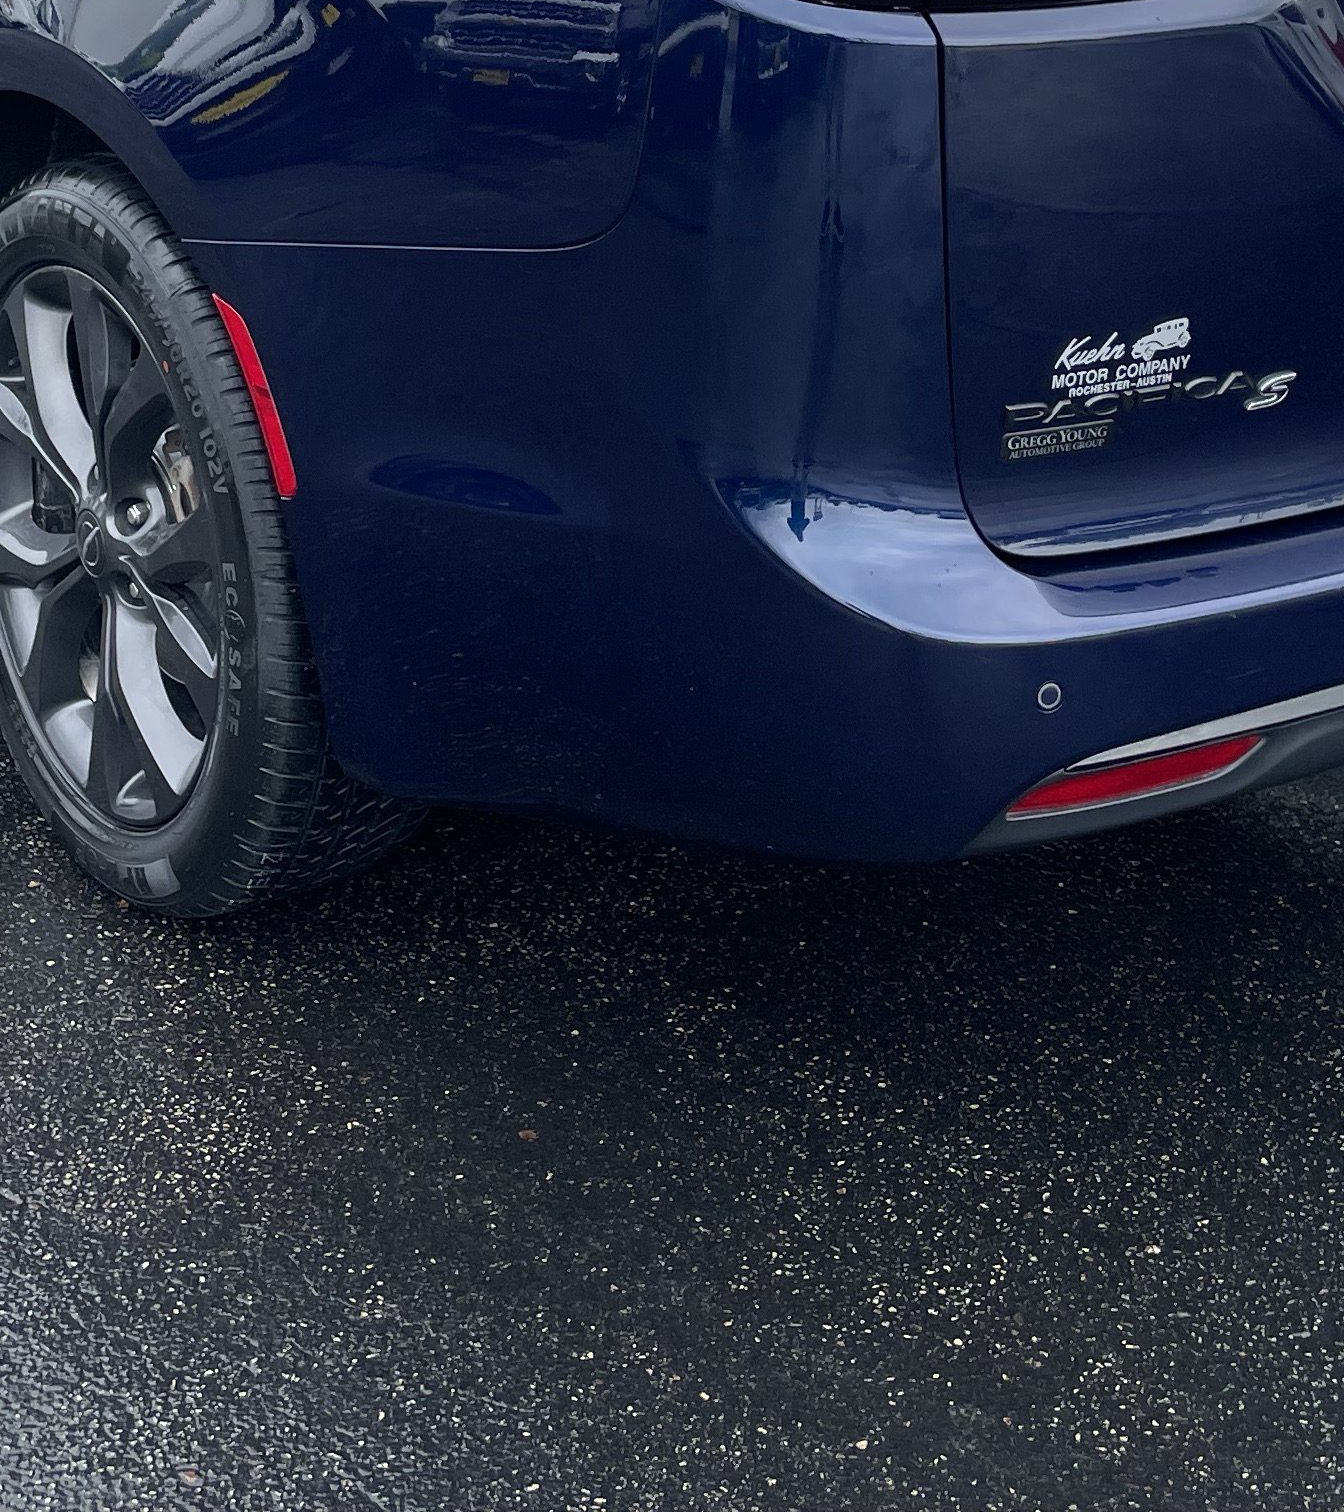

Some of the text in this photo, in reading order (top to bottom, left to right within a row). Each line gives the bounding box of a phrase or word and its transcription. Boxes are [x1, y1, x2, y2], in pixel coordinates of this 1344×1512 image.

[1054, 331, 1126, 370] Kuehn
[1051, 354, 1191, 390] MOTOR COMPANY
[1007, 425, 1108, 451] GREGG YOUNG
[1008, 438, 1105, 460] AUTOMOTIVE GROUP
[199, 427, 229, 494] 102V
